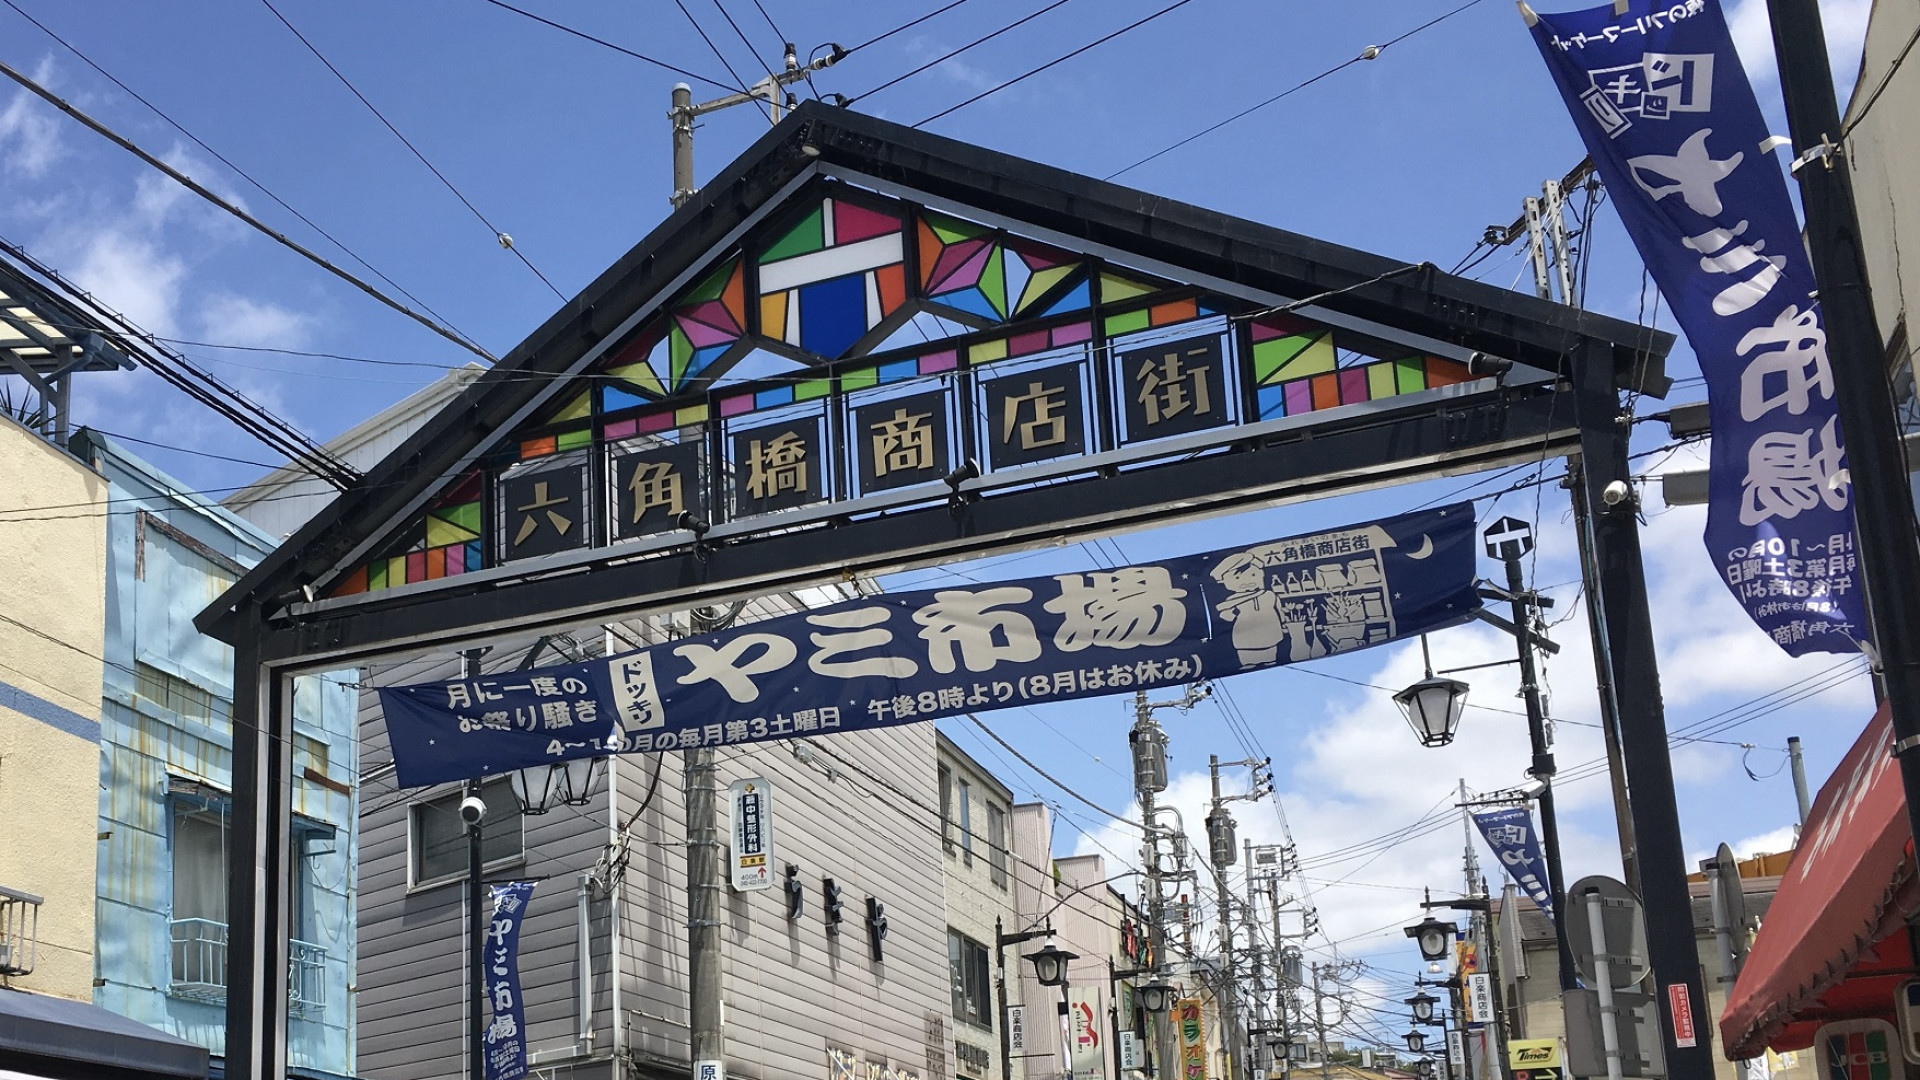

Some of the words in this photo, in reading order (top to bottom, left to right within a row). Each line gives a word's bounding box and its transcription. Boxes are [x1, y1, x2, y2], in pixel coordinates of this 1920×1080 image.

[513, 348, 1212, 547] 六角橋商店街
[1264, 534, 1370, 565] 六角橋商店街
[446, 676, 588, 710] 月に一度の
[621, 660, 653, 725] ドッキリ
[458, 699, 598, 733] お祭り騒ぎ
[1182, 1004, 1202, 1079] カラオケ
[1516, 1046, 1553, 1061] Times
